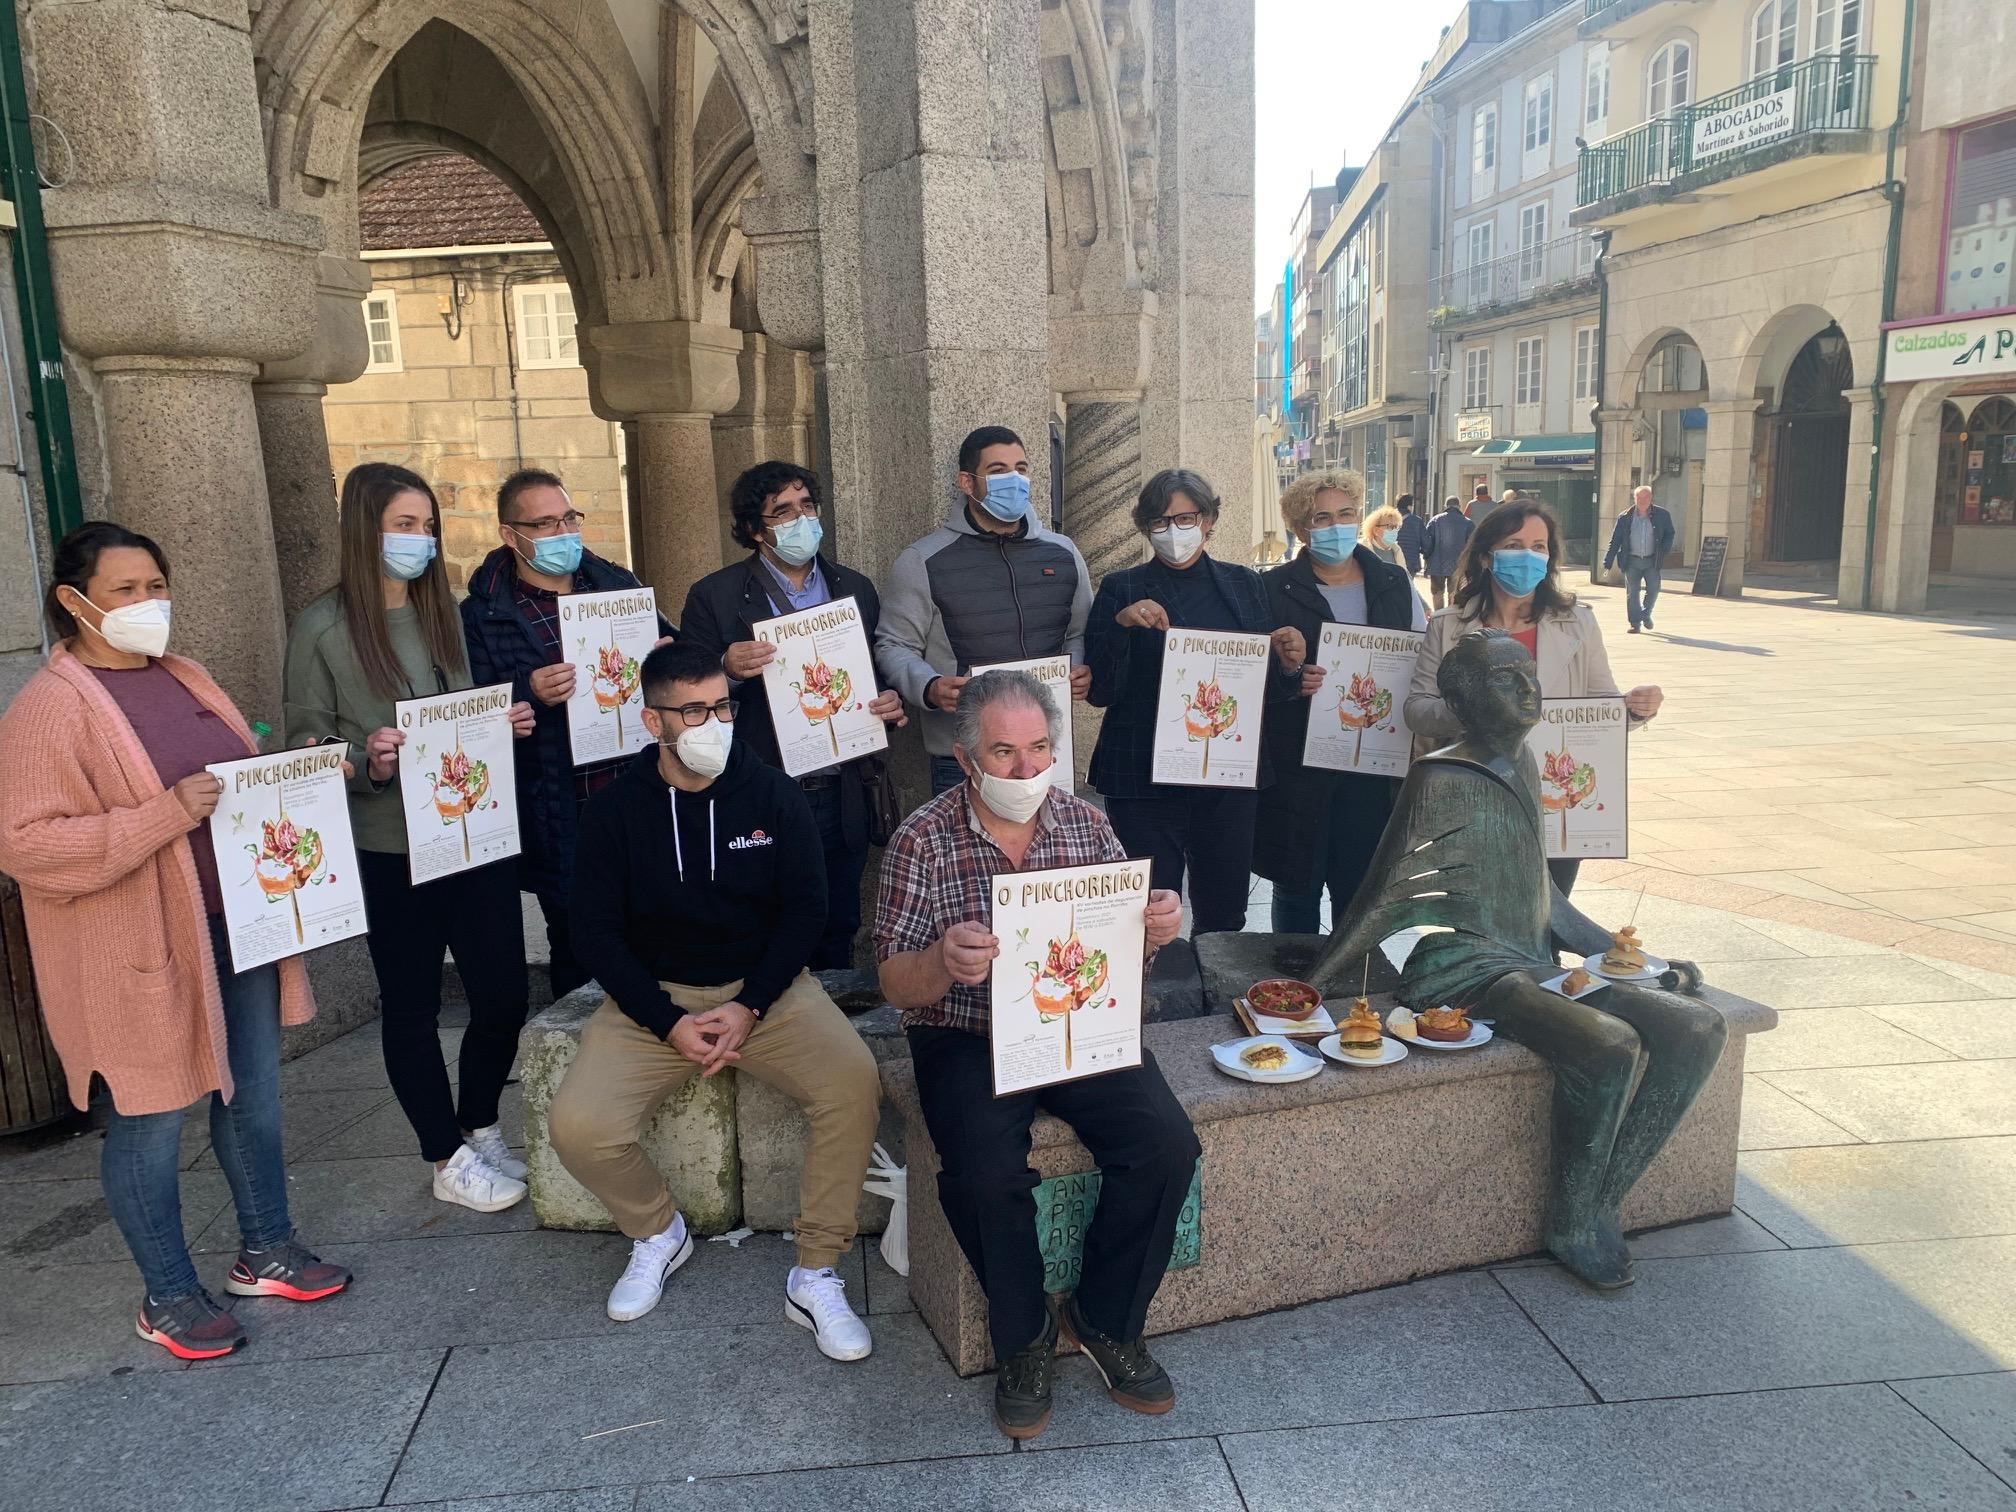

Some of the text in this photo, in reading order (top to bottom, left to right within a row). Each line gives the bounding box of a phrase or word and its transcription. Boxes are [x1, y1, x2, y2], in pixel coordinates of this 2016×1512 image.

[1703, 96, 1784, 138] ABOGADOS
[1737, 130, 1745, 141] &
[1748, 115, 1790, 138] Saborido
[1894, 330, 1969, 353] Calzados
[562, 592, 653, 622] O PINCHORRIÑO
[774, 603, 857, 644] PINCHORRIÑO
[1168, 636, 1265, 657] O PINCHORRIÑO
[1323, 631, 1423, 654] O PINCHORRIÑO
[401, 711, 412, 728] O
[420, 688, 508, 728] PINCHORRIÑO
[235, 748, 341, 794] PINCHORRIÑO
[728, 836, 774, 850] ellesse
[998, 866, 1145, 908] O PINCHORRIÑO
